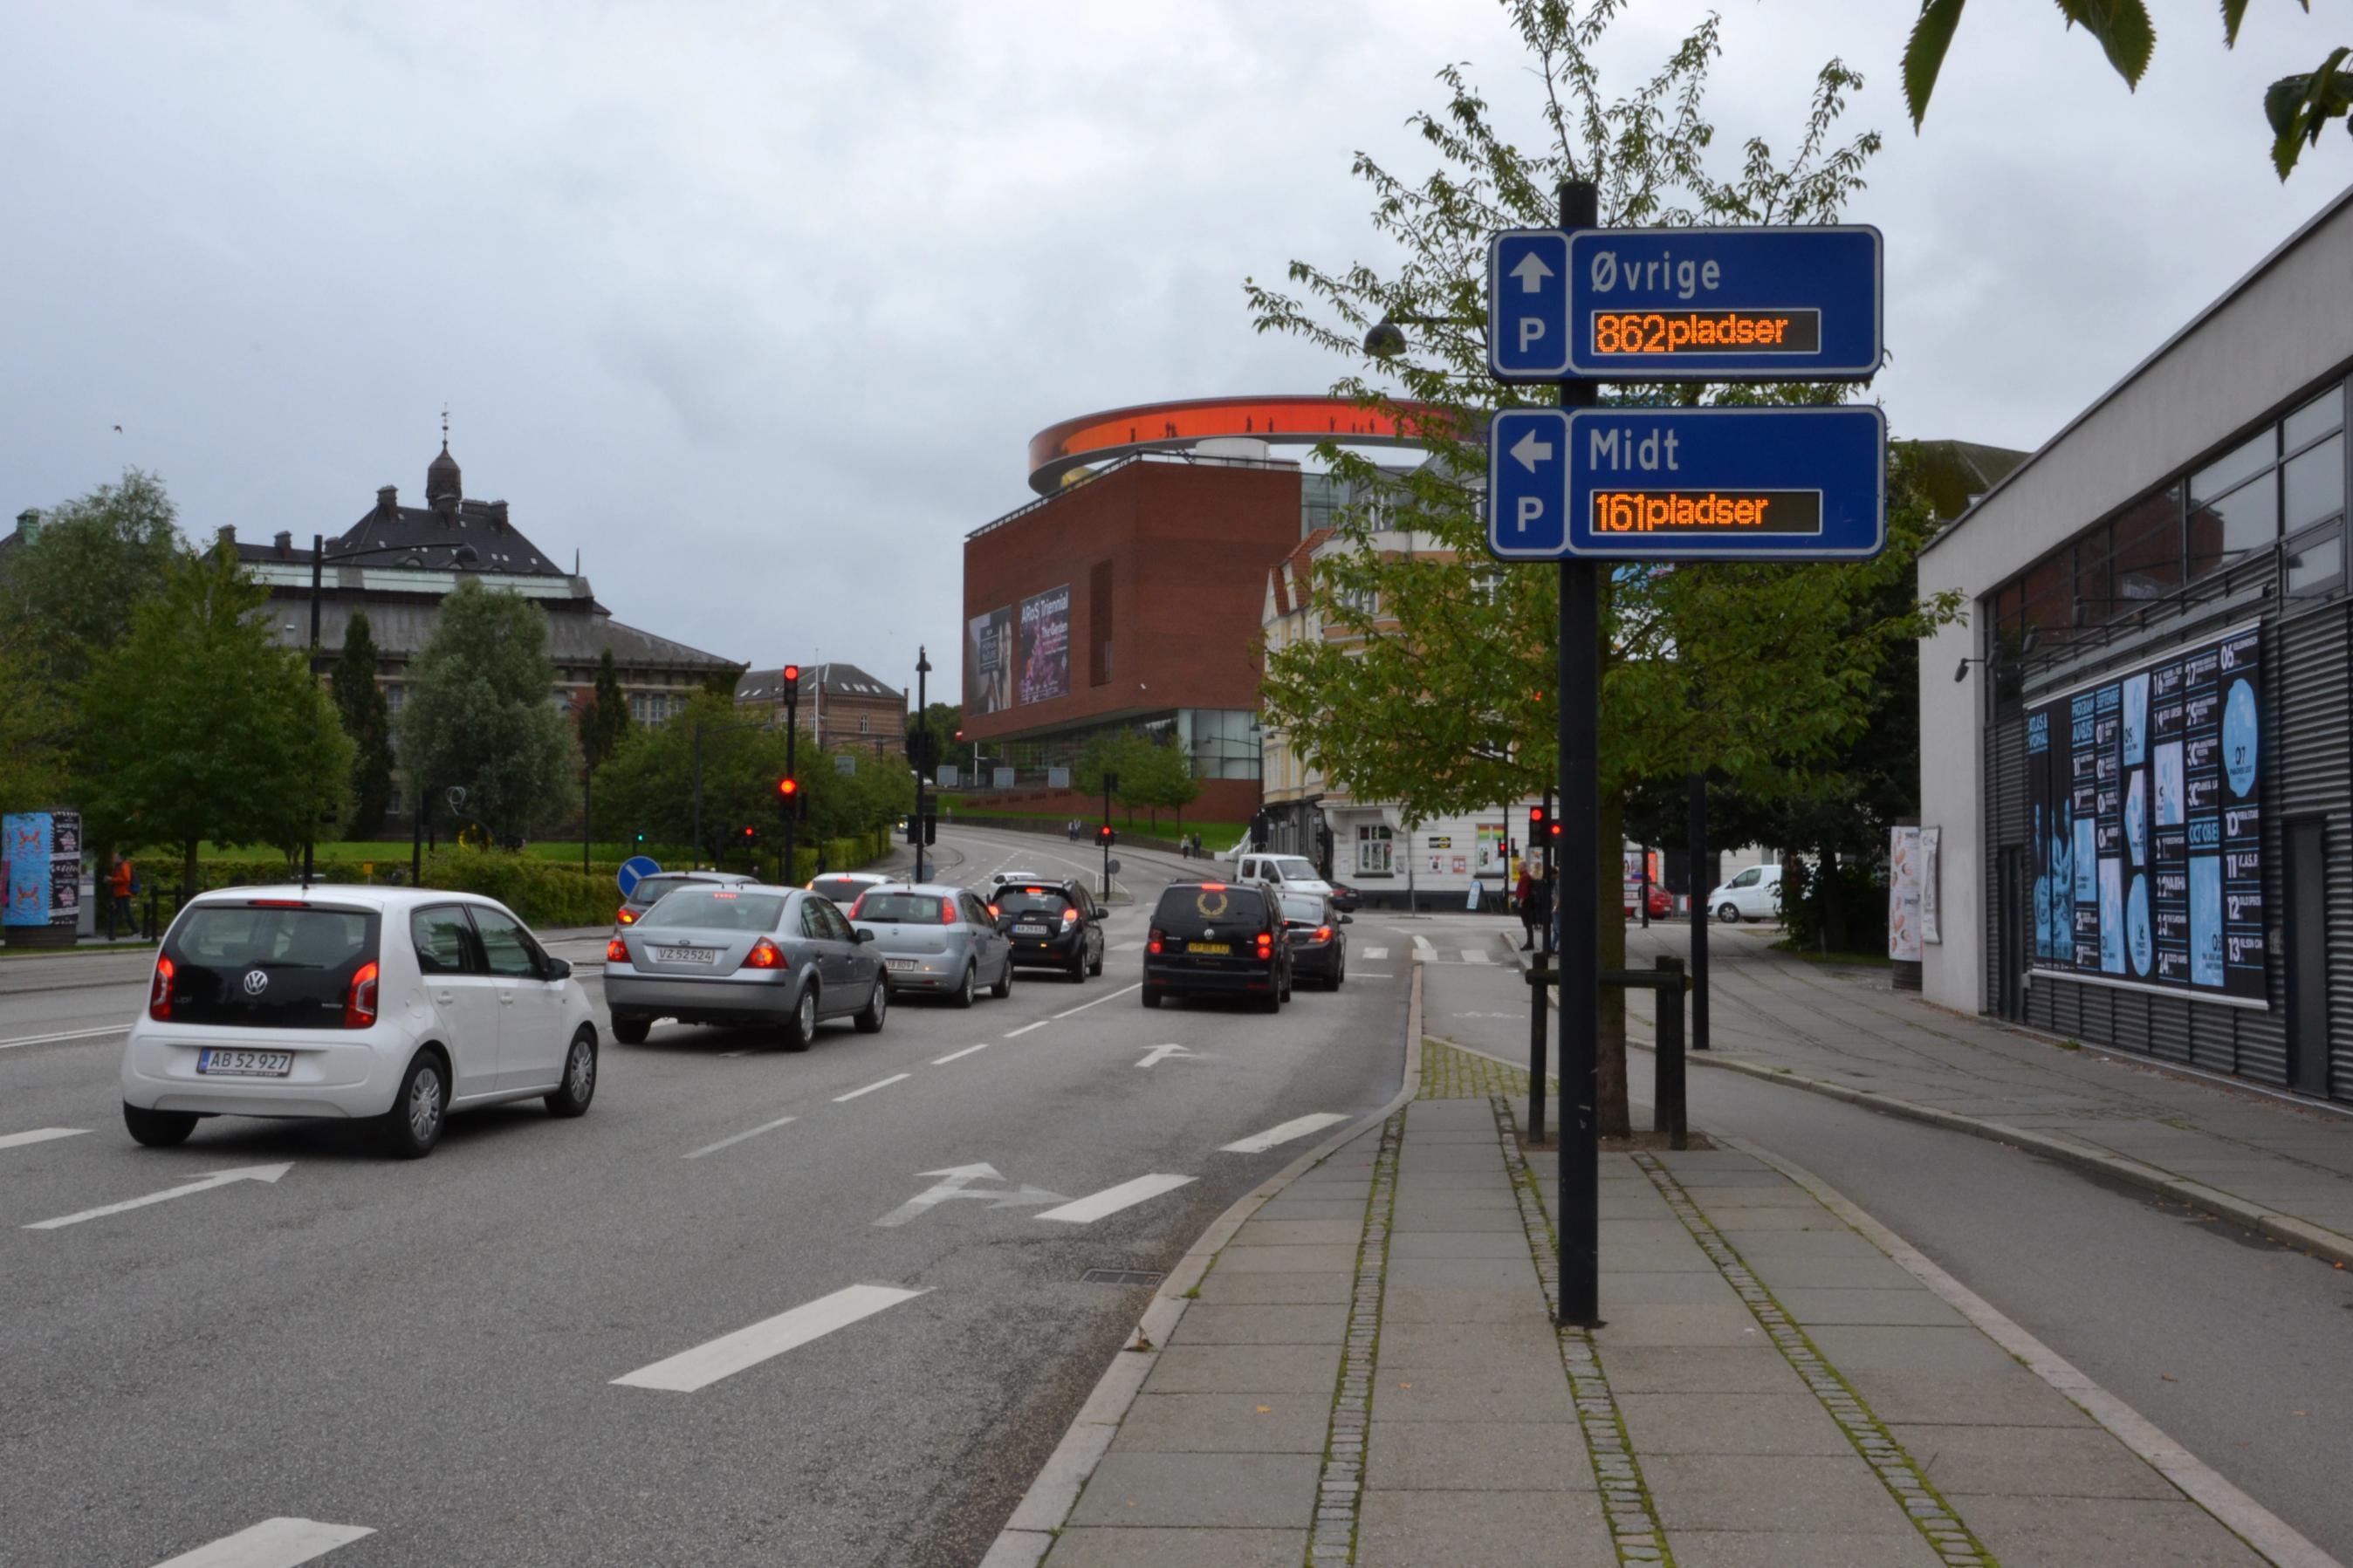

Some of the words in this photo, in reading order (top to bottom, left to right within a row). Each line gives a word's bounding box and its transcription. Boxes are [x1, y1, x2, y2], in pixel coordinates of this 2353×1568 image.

[1591, 251, 1720, 298] Øvrige
[1520, 318, 1545, 352] P
[1589, 428, 1679, 470] Midt
[1518, 496, 1543, 531] P
[1040, 592, 1068, 617] Triennial
[2221, 643, 2234, 670] 06
[2153, 672, 2164, 696] 16
[2226, 853, 2238, 879] 11
[2227, 895, 2240, 921] 12
[2227, 936, 2240, 962] 13
[210, 1053, 231, 1067] AB
[235, 1053, 254, 1068] 52
[259, 1055, 288, 1070] 927
